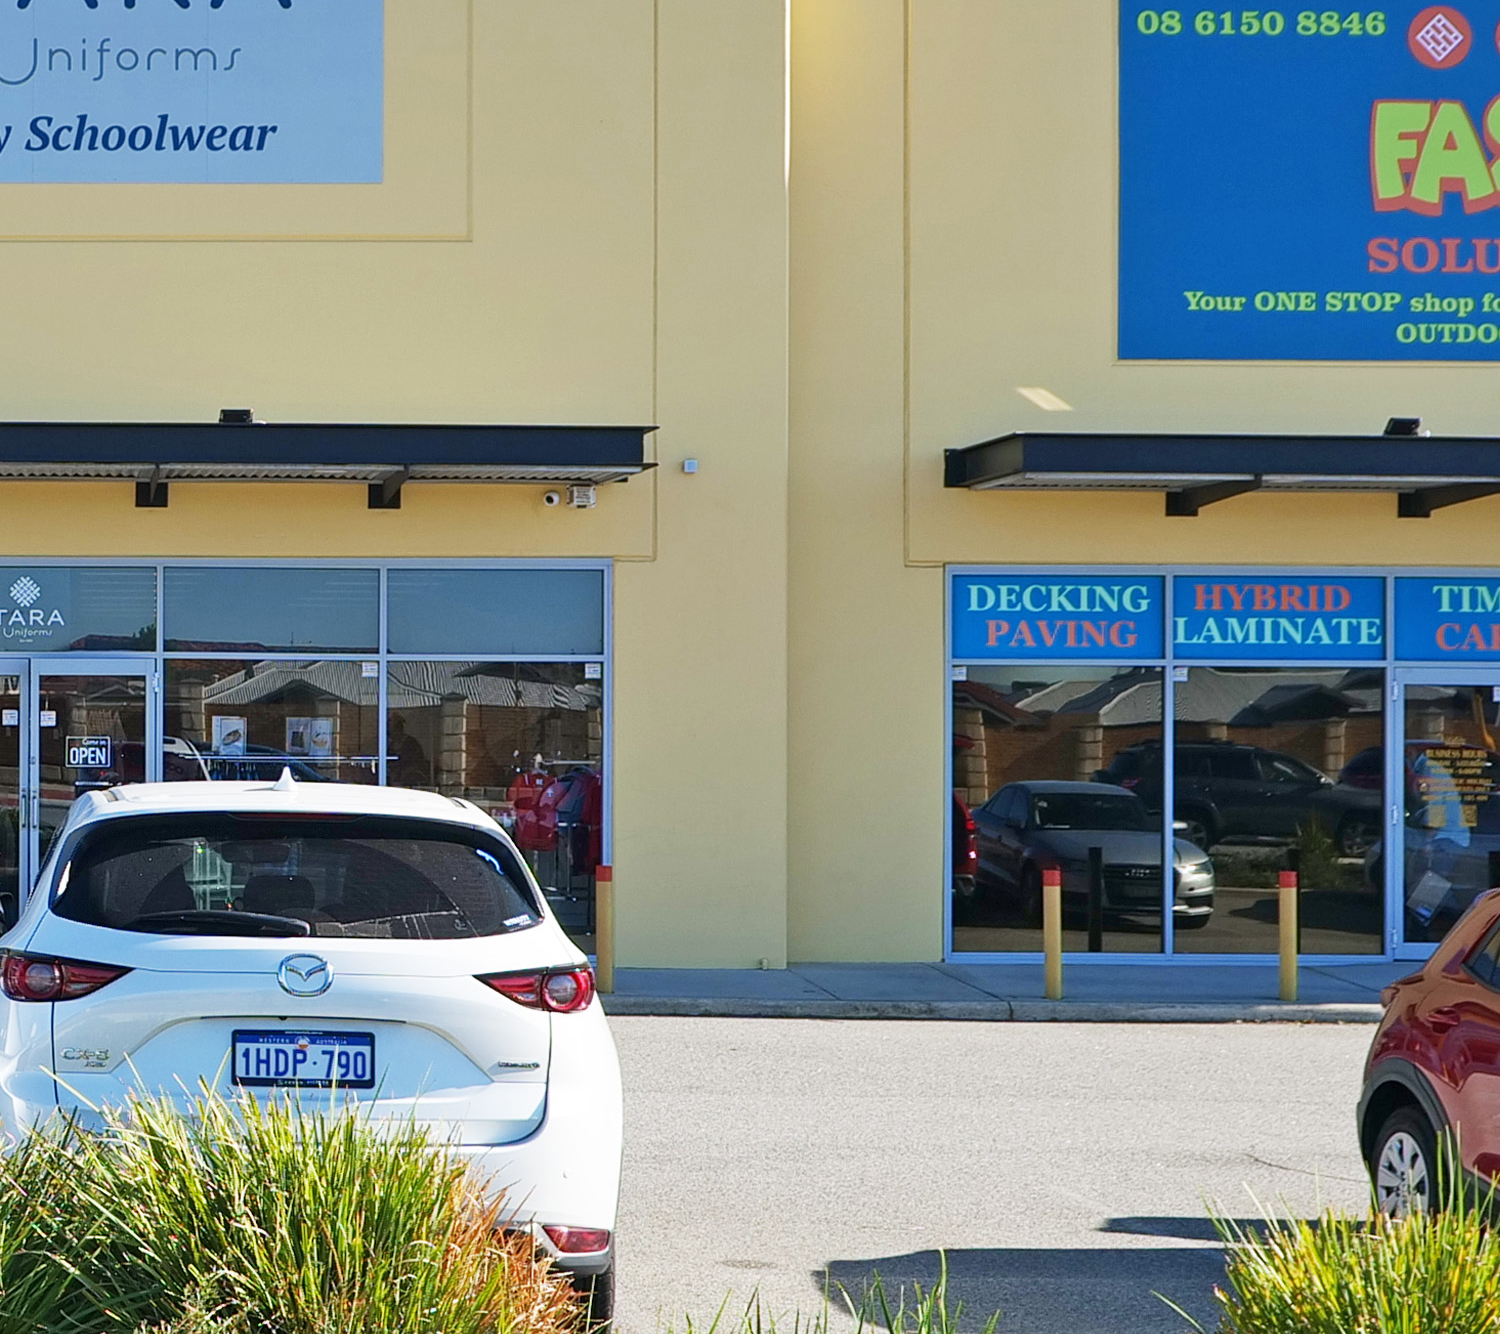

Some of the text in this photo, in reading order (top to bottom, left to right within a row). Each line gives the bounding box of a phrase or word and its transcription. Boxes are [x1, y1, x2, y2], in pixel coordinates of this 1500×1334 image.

[1137, 10, 1387, 36] 08 6150 8846
[25, 114, 278, 153] Schoolwear
[1184, 291, 1246, 312] Your
[1254, 291, 1317, 312] ONE
[1325, 291, 1402, 312] STOP
[1410, 293, 1475, 317] shop
[968, 584, 1150, 613] DECKING
[1194, 584, 1352, 612] HYBRID
[3, 627, 53, 638] Uniforms
[986, 620, 1139, 648] PAVING
[1174, 617, 1382, 645] LAMINATE
[69, 747, 106, 764] OPEN
